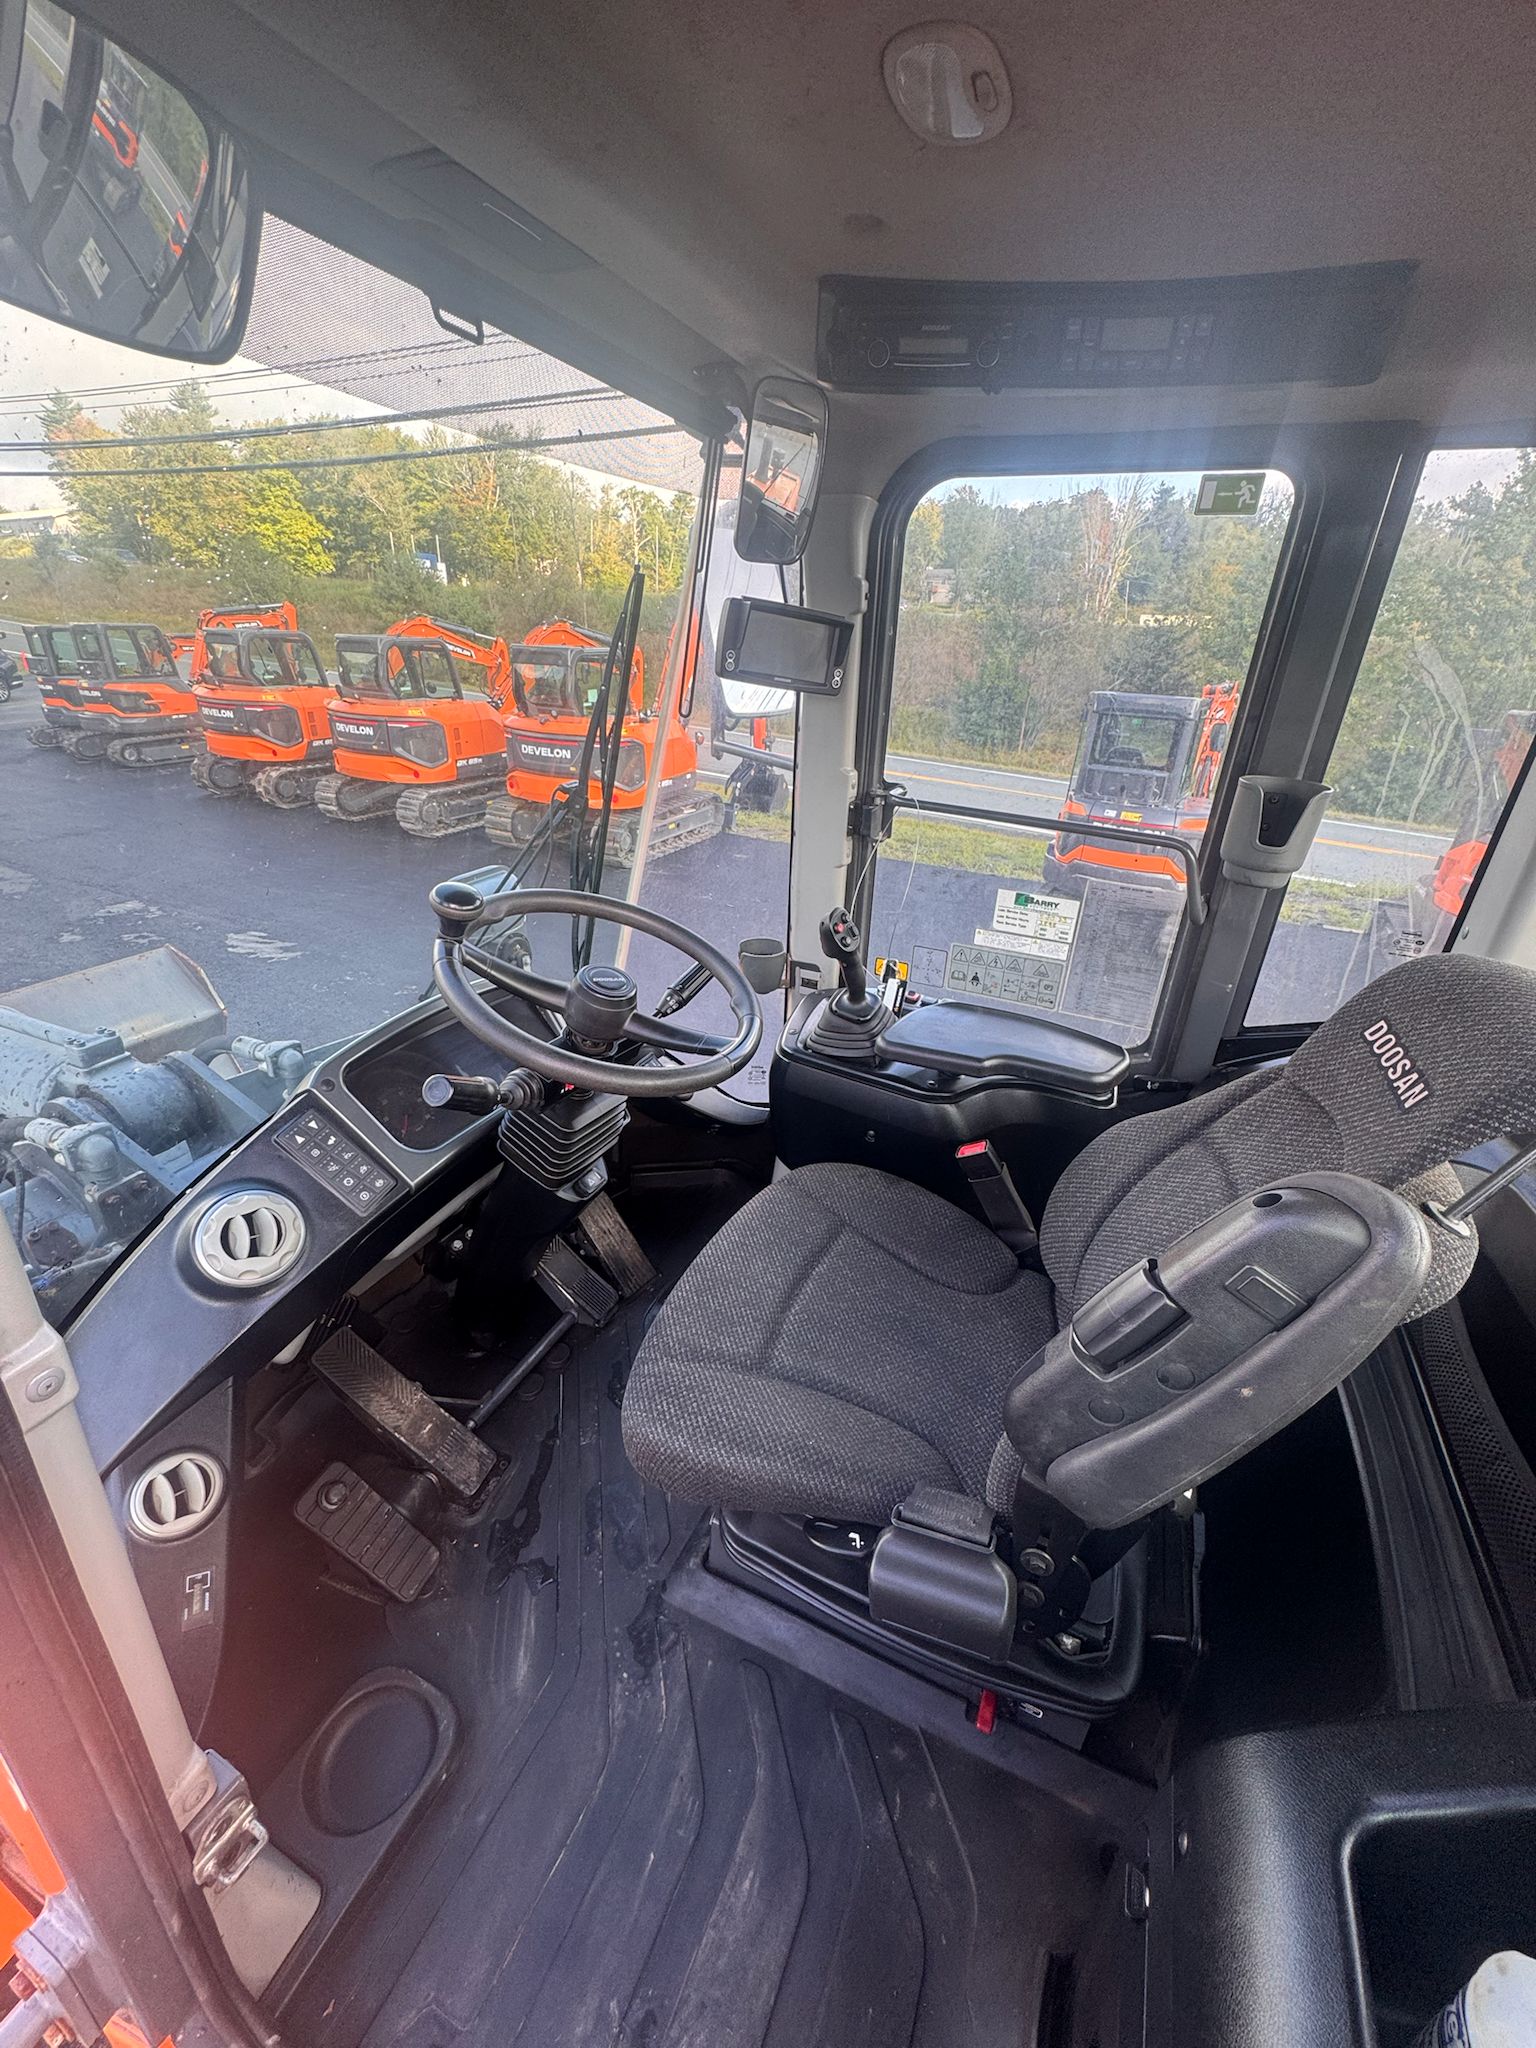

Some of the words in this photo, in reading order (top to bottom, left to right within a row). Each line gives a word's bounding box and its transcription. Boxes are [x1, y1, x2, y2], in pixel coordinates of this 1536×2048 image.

[335, 722, 374, 736] DEVELON
[521, 744, 571, 759] DEVELON
[1027, 896, 1060, 909] BARRY
[1364, 1020, 1428, 1109] DOOSAN
